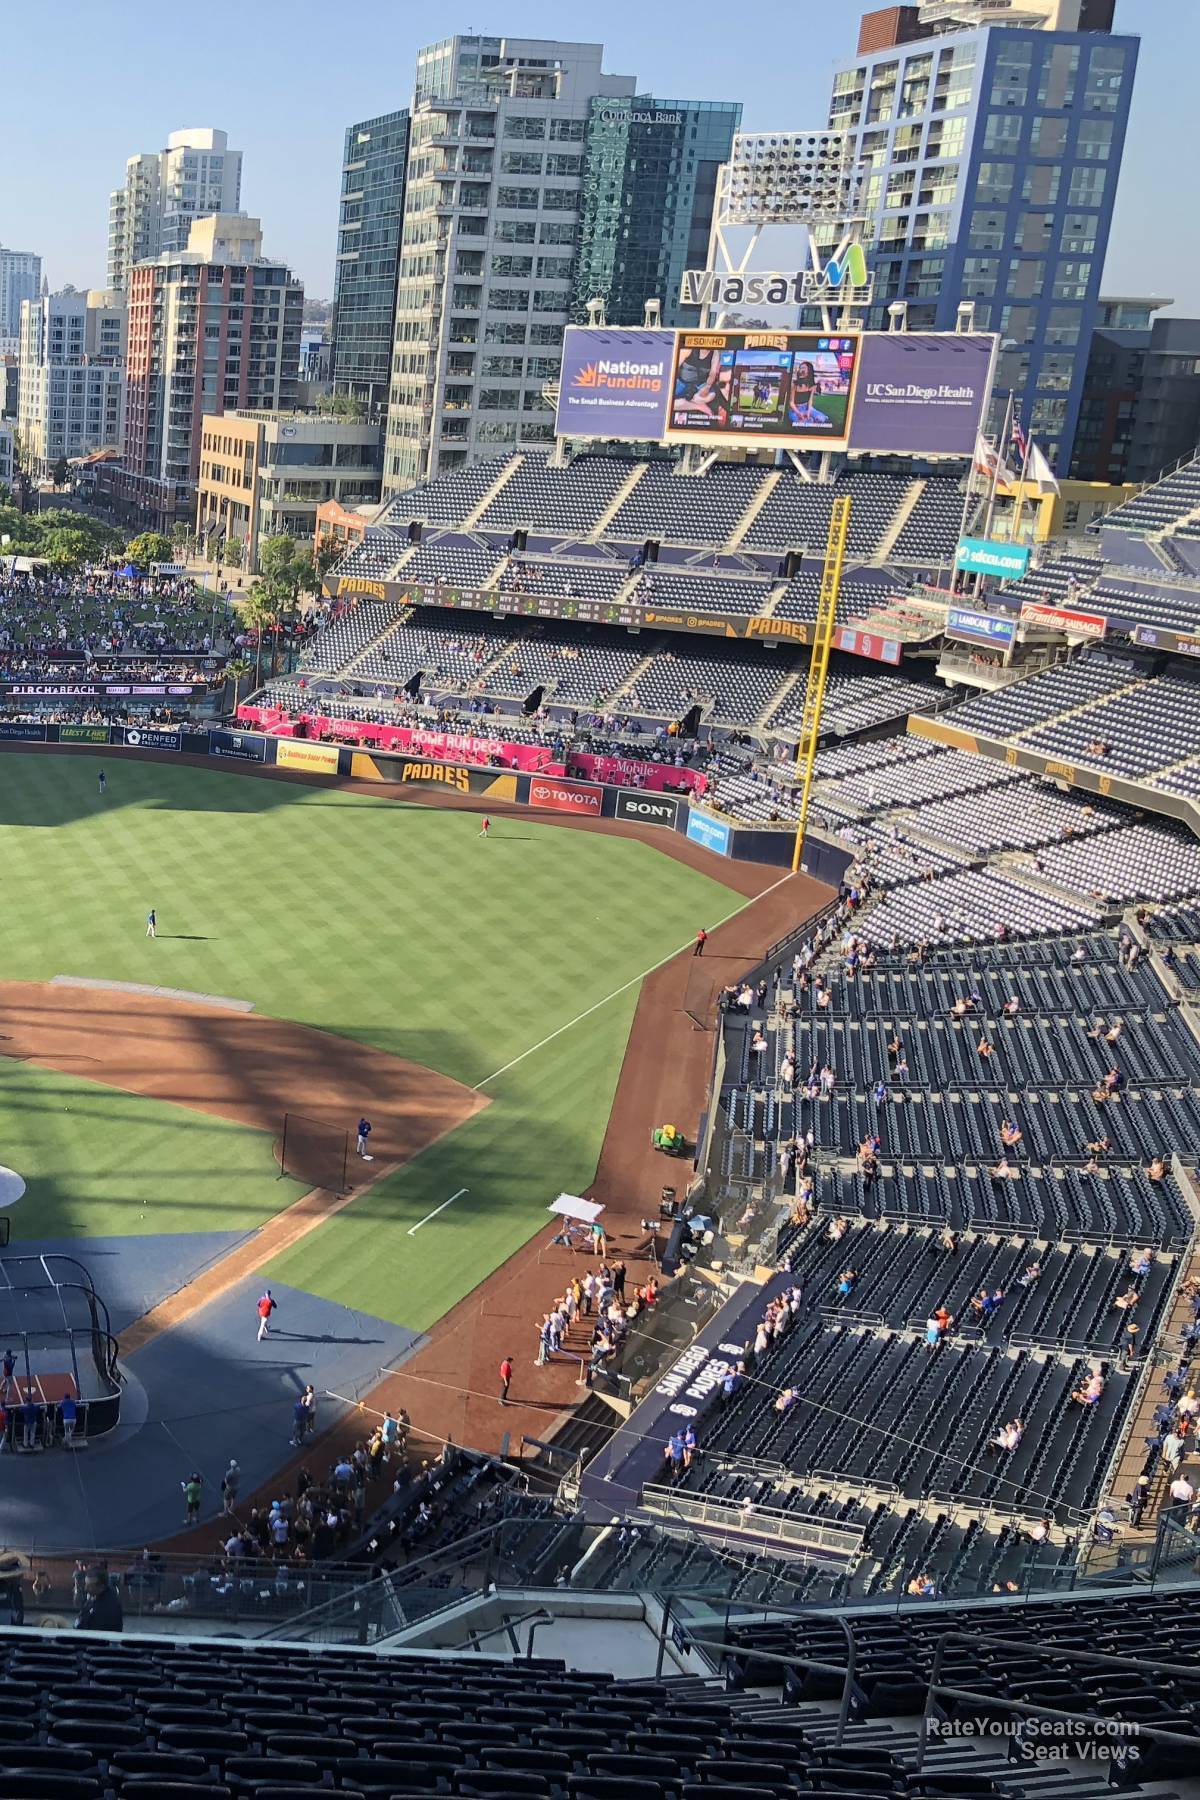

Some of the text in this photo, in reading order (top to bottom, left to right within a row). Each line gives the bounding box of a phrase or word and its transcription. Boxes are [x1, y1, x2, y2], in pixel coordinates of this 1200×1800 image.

[655, 112, 682, 123] Bank
[686, 270, 809, 305] Viasat
[744, 335, 789, 352] PADRES
[598, 360, 664, 376] National
[596, 374, 662, 392] Funding
[866, 383, 974, 399] UC San Diego Health
[581, 397, 597, 405] Small
[598, 398, 625, 406] Business
[625, 400, 659, 409] Advantage
[970, 550, 1025, 570] sdccu.com
[336, 576, 386, 600] PADRES
[1022, 604, 1101, 635] Tarantino SAUSAGES
[744, 618, 808, 643] PADRES
[12, 686, 50, 694] PIRCH
[59, 685, 96, 694] BEACH
[0, 727, 9, 735] San
[9, 728, 25, 737] Diego
[61, 728, 85, 737] WEST
[141, 732, 177, 744] PENFED
[410, 731, 505, 755] HOME RUN DECK
[401, 761, 470, 793] PADRES
[1044, 760, 1076, 784] PADRES
[551, 789, 599, 806] TOYOTA
[624, 801, 674, 819] SONY
[690, 818, 726, 841] petco.com
[655, 1345, 710, 1397] SAN DIEGO
[684, 1358, 731, 1400] PADRES
